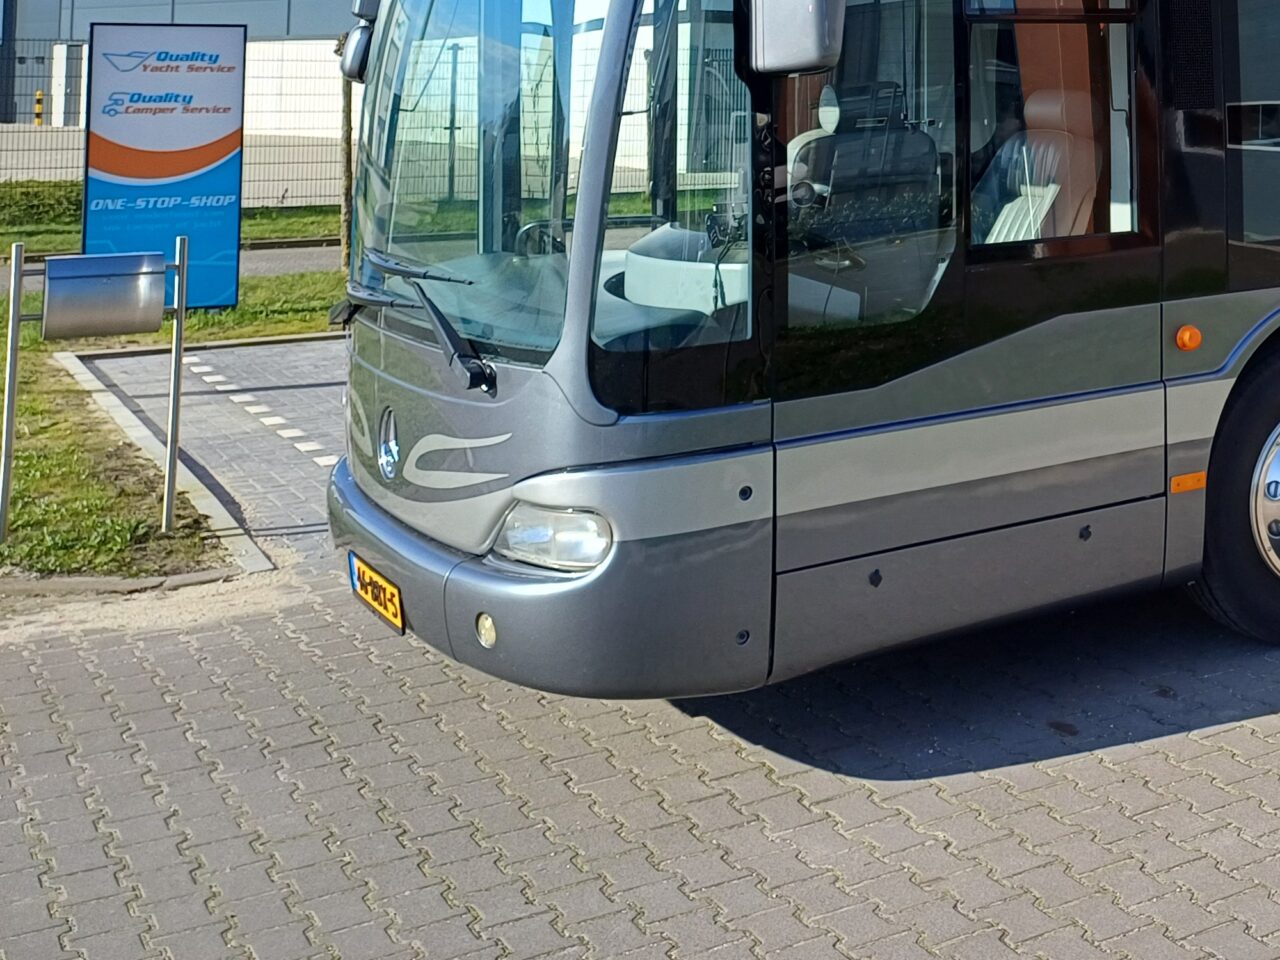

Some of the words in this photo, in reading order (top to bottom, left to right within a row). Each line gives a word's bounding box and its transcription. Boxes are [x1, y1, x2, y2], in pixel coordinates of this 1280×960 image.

[156, 51, 219, 64] Quality
[142, 64, 179, 72] Yacht
[186, 64, 236, 72] Service
[129, 93, 193, 105] Quality
[124, 106, 176, 115] Camper
[181, 105, 232, 114] Service
[90, 195, 236, 210] ONE-STOP-SHOP
